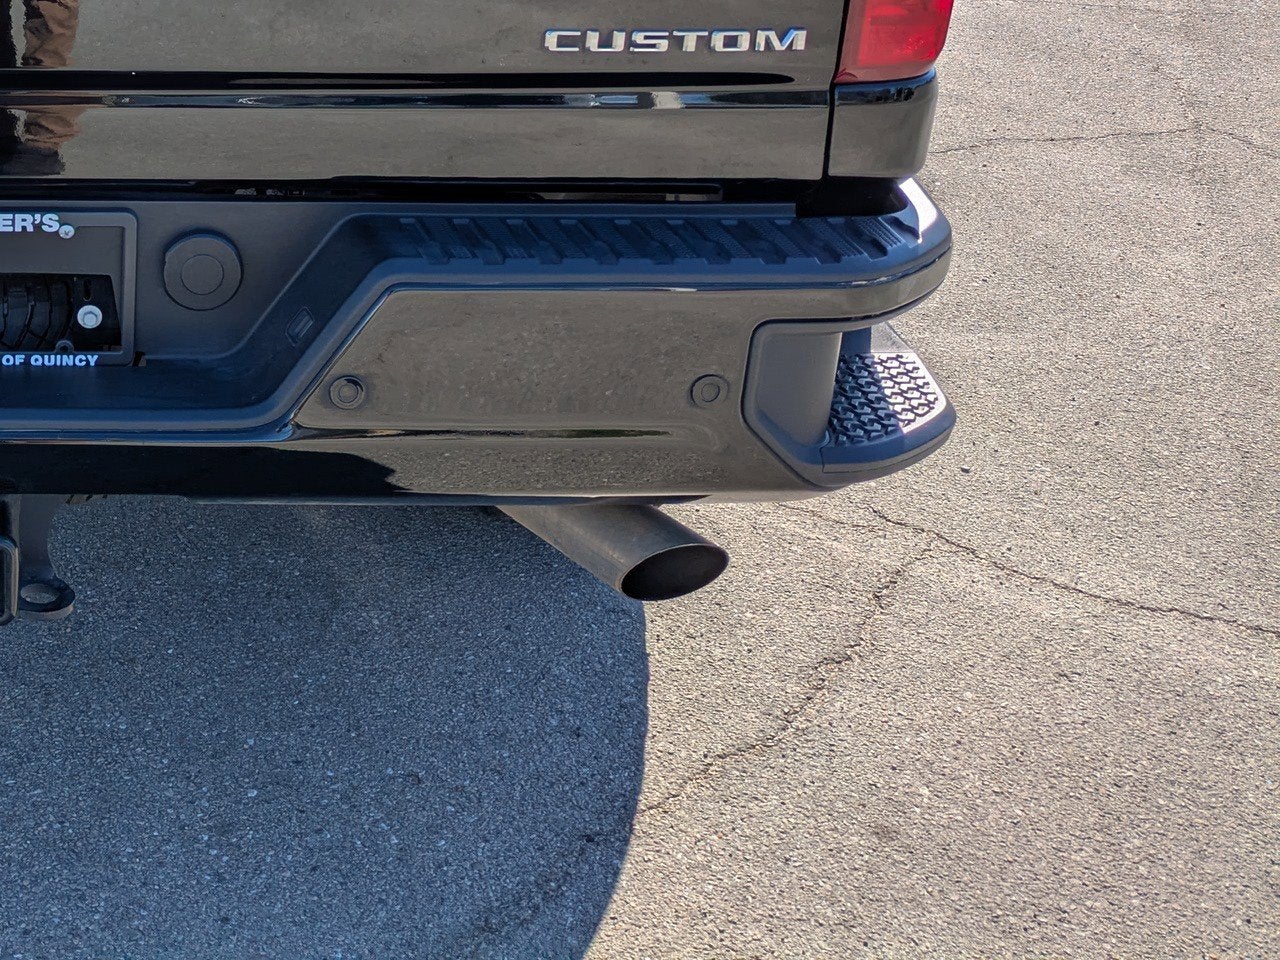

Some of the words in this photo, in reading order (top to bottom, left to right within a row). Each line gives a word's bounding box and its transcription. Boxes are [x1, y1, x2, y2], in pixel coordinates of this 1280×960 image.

[543, 27, 808, 53] CUSTOM
[1, 354, 25, 366] OF
[30, 354, 99, 367] QUINCY
